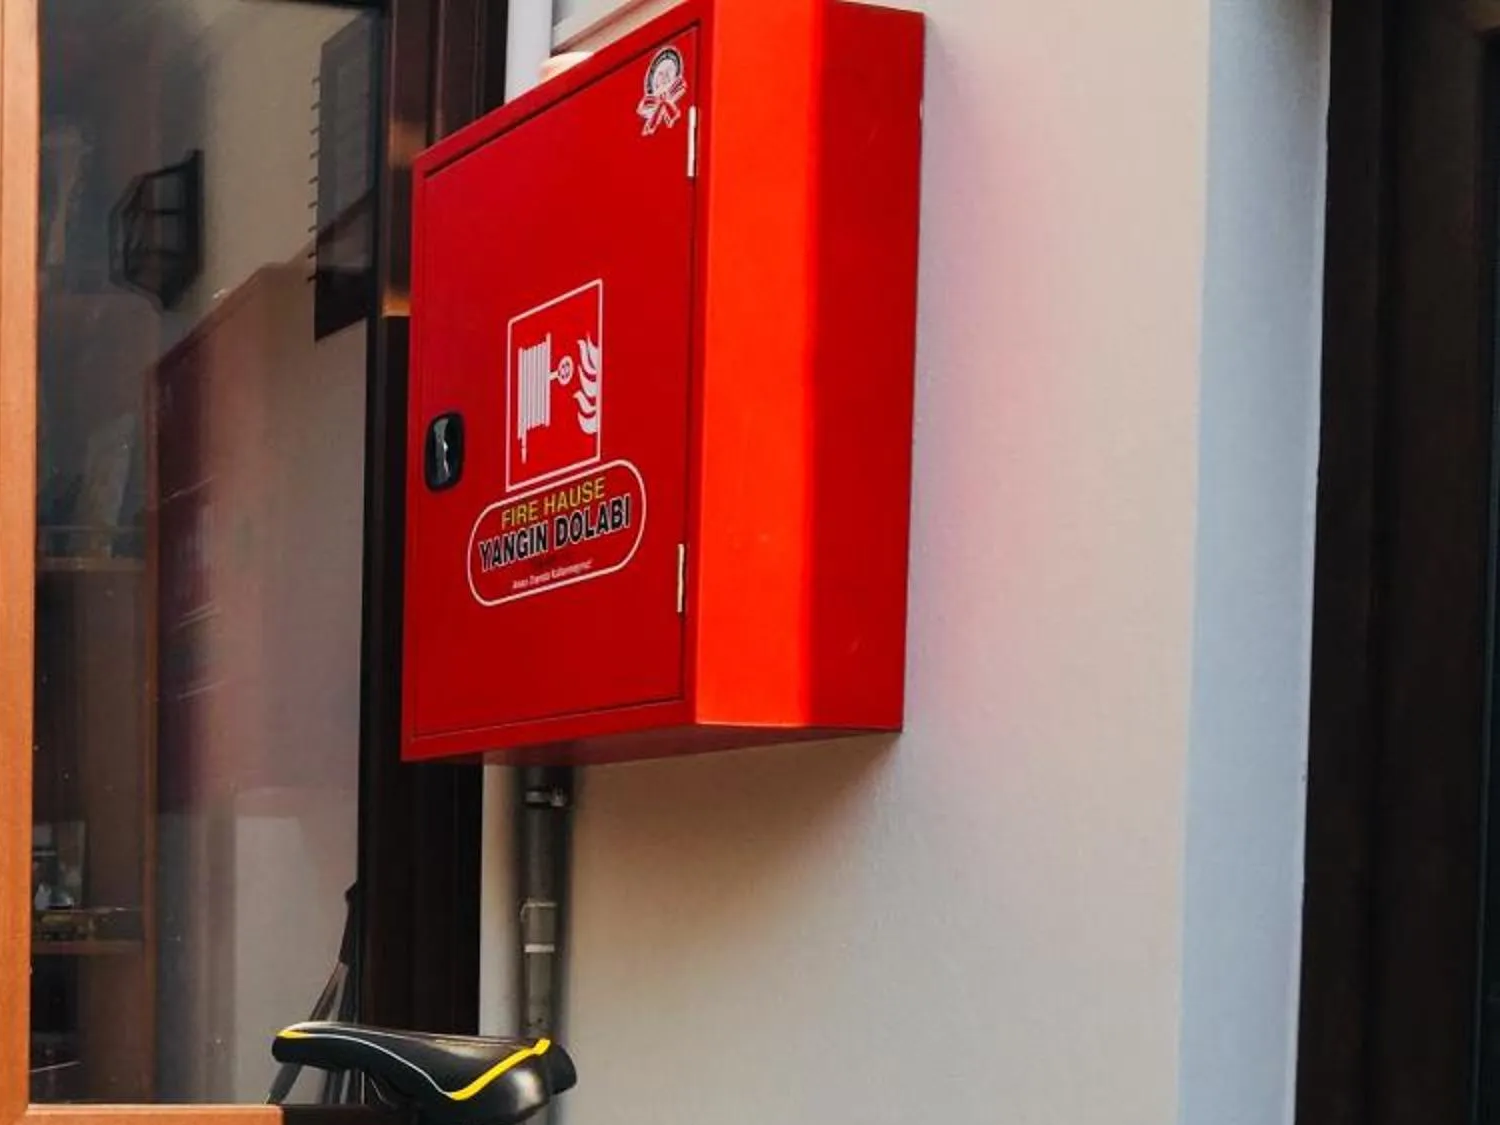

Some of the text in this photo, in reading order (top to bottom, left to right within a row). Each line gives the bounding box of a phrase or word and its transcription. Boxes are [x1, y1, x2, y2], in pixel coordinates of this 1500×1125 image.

[478, 493, 631, 573] YANGIN DOLABI
[501, 477, 606, 530] FIRE HAUSE
